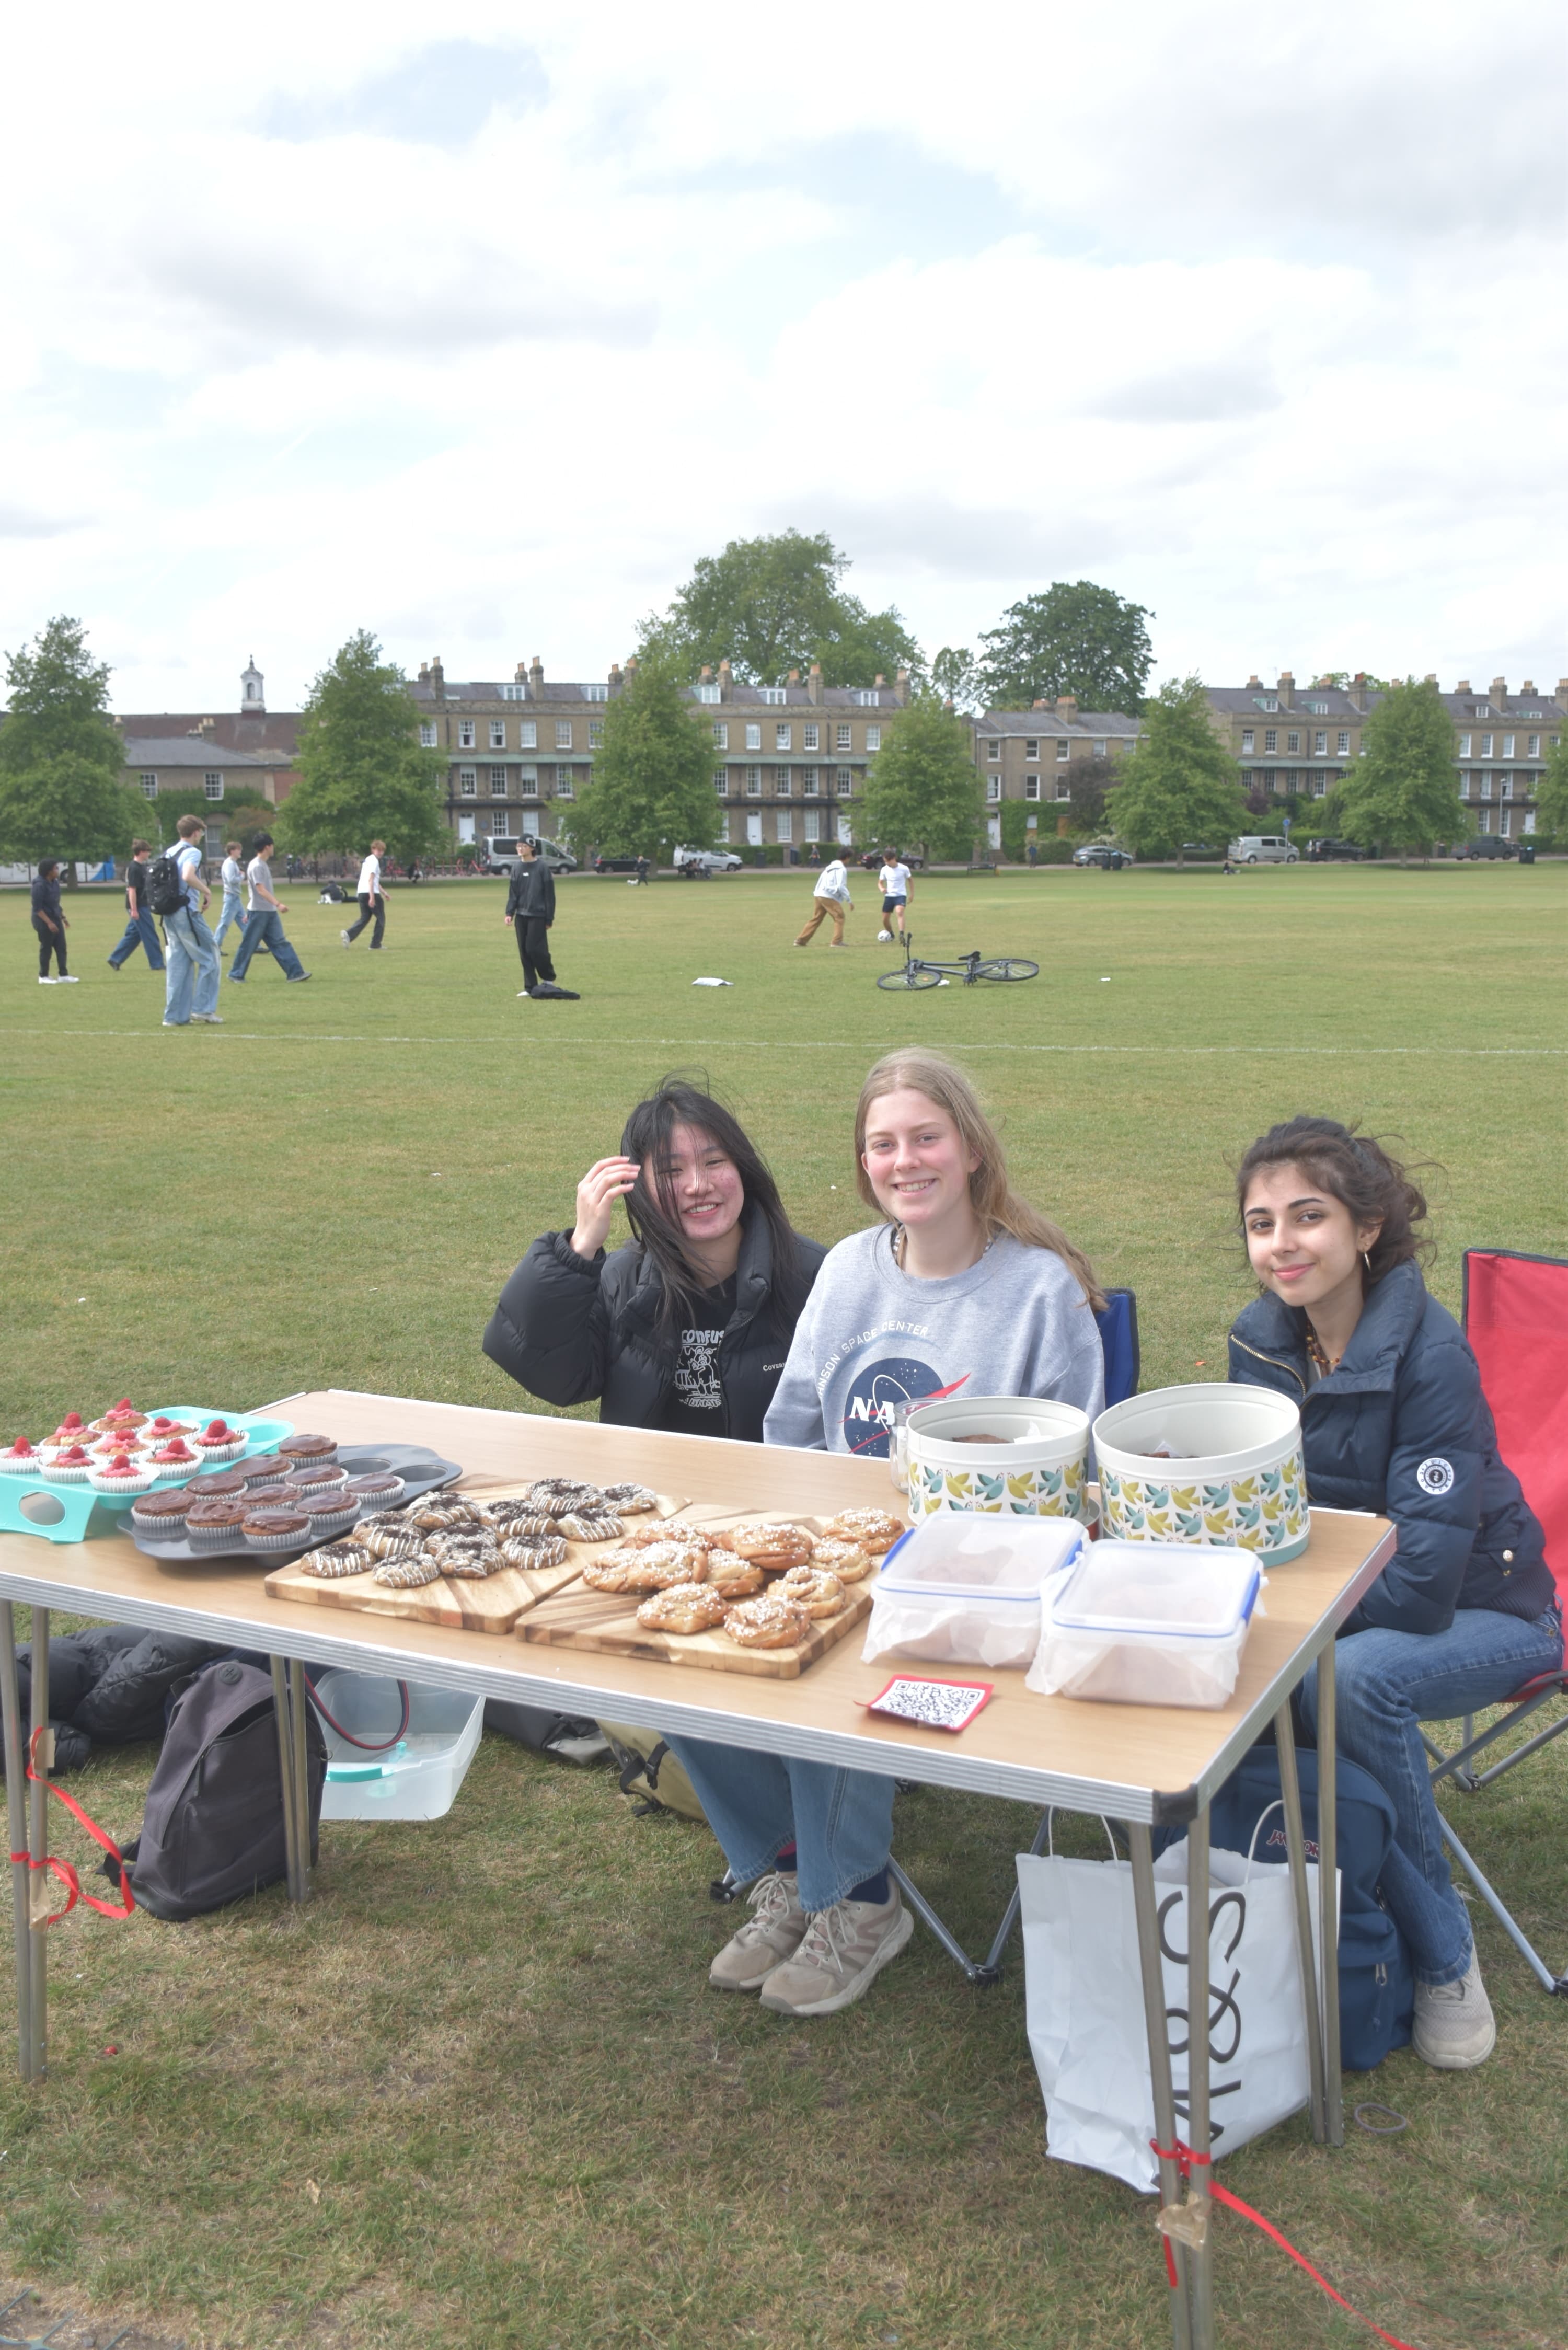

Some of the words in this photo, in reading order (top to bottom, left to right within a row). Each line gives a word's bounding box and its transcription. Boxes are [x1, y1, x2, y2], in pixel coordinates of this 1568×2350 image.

[817, 1353, 841, 1396] HNSON
[841, 1327, 878, 1354] SPACE
[881, 1320, 929, 1337] CENTER
[849, 1396, 895, 1425] NA
[1266, 1829, 1319, 1858] JANOR
